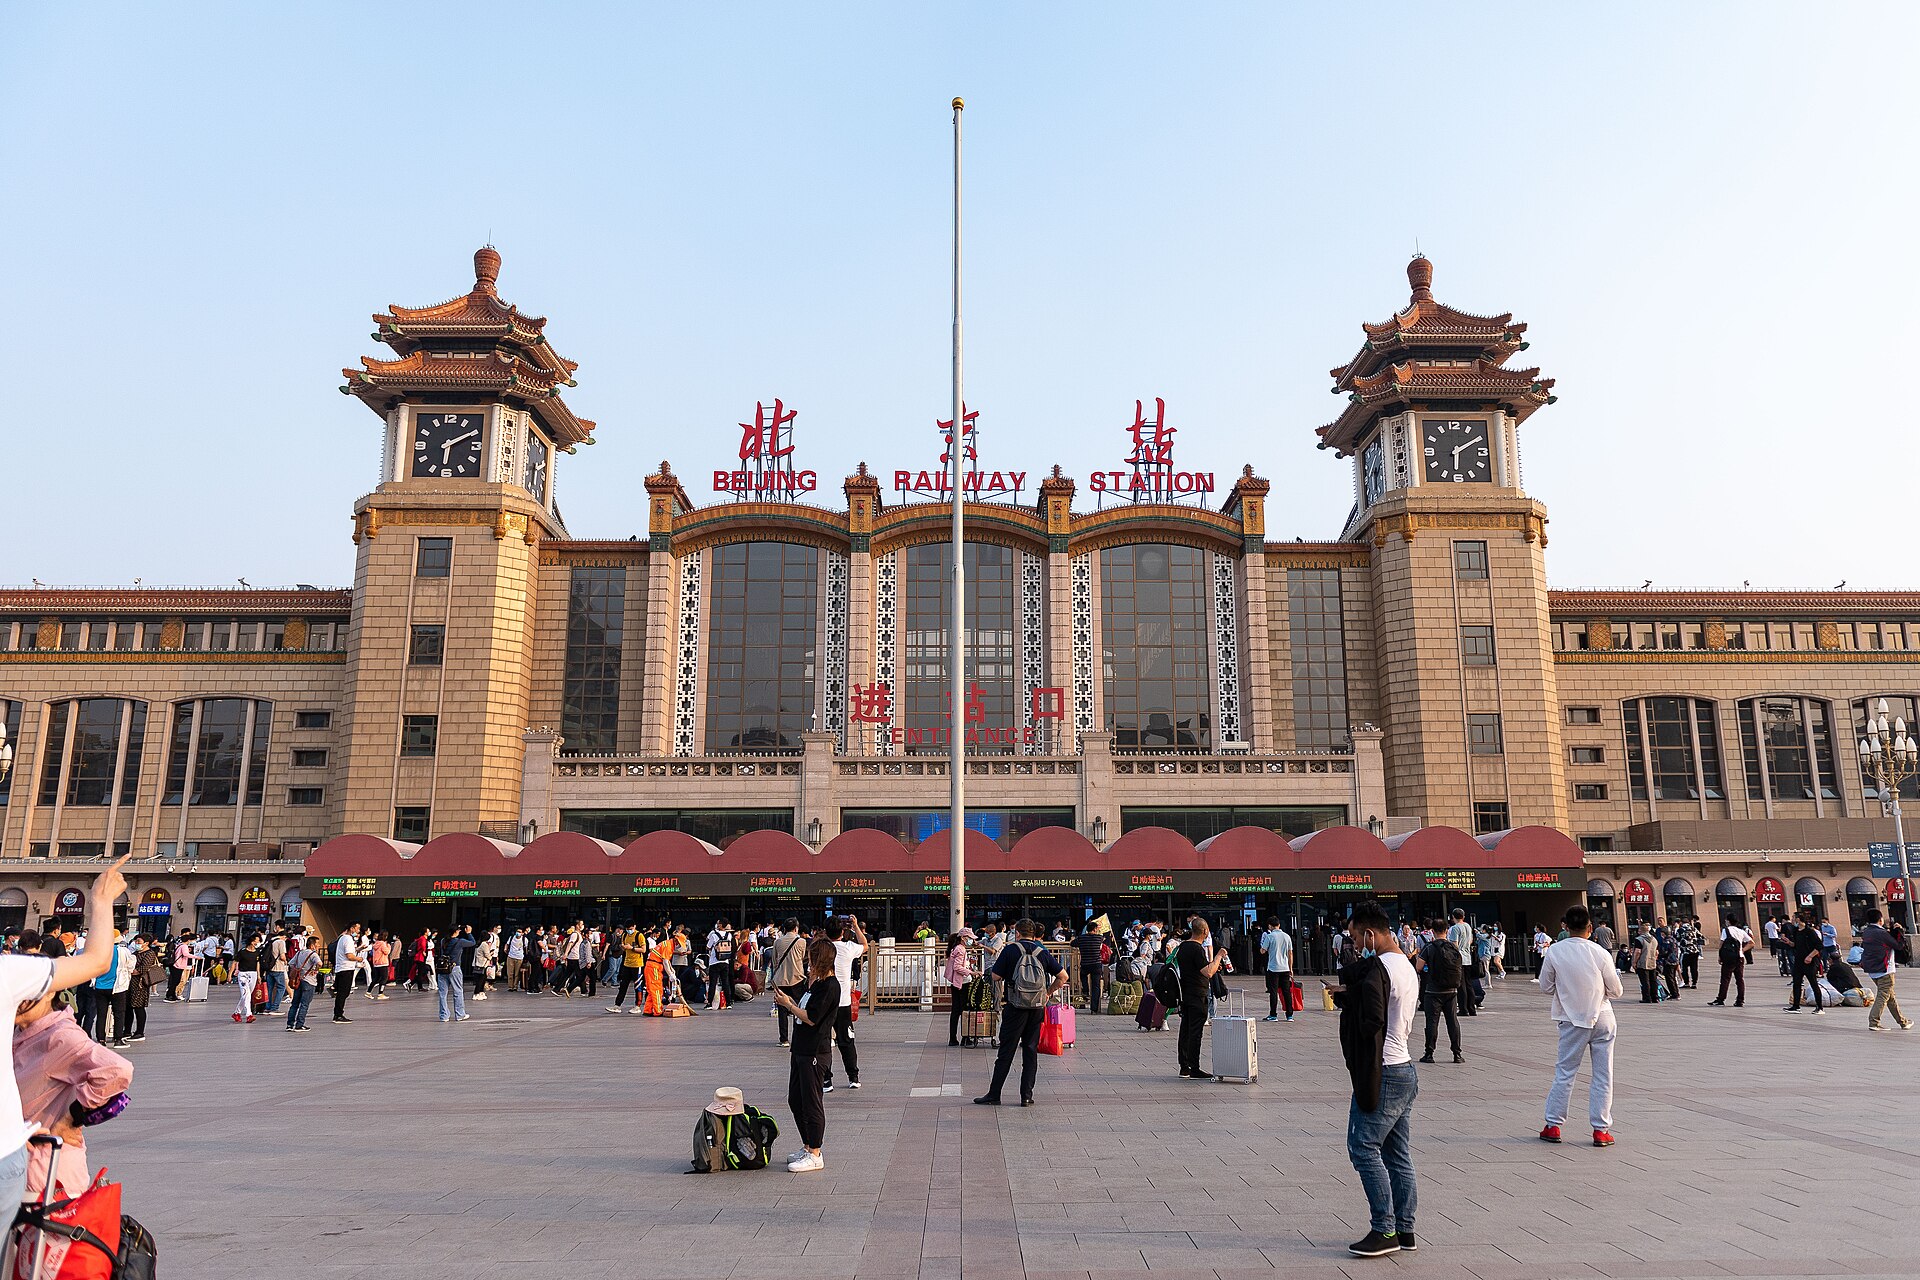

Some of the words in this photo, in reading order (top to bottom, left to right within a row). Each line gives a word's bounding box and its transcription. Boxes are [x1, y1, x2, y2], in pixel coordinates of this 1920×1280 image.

[444, 414, 458, 424] 12
[1448, 421, 1461, 430] 12
[415, 441, 427, 450] 9
[471, 441, 483, 451] 3
[1424, 447, 1435, 457] 9
[1477, 447, 1489, 457] 3
[440, 468, 453, 478] 6
[1453, 473, 1464, 483] 6
[713, 470, 817, 491] BEIJING
[894, 470, 1027, 491] RAILWAY
[1089, 471, 1215, 493] STATION
[850, 682, 1065, 724] 进站口
[1761, 893, 1782, 901] KFC
